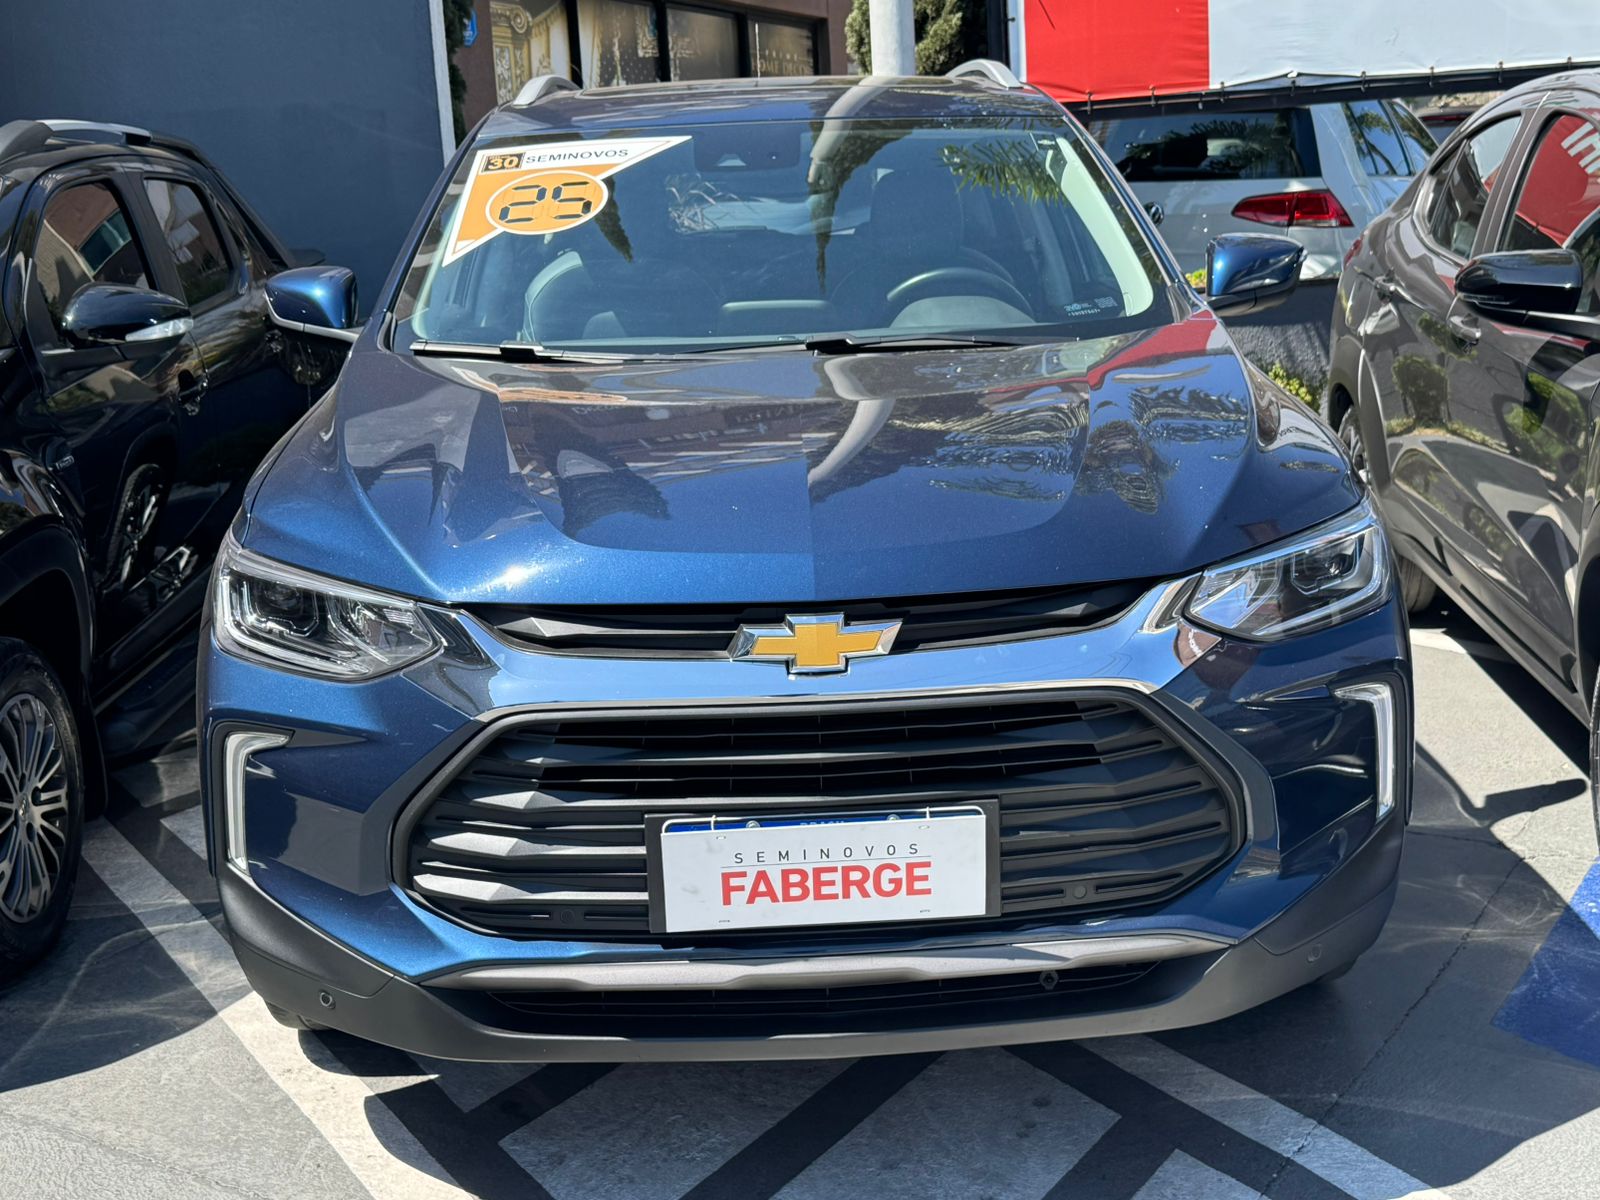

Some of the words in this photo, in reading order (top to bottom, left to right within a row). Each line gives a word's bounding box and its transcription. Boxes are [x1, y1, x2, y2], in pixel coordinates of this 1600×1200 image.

[488, 156, 519, 170] 30
[525, 148, 629, 164] SEMINOVOS
[498, 180, 593, 224] 25
[734, 843, 919, 864] SEMINOVOS
[720, 861, 932, 906] FABERGE
